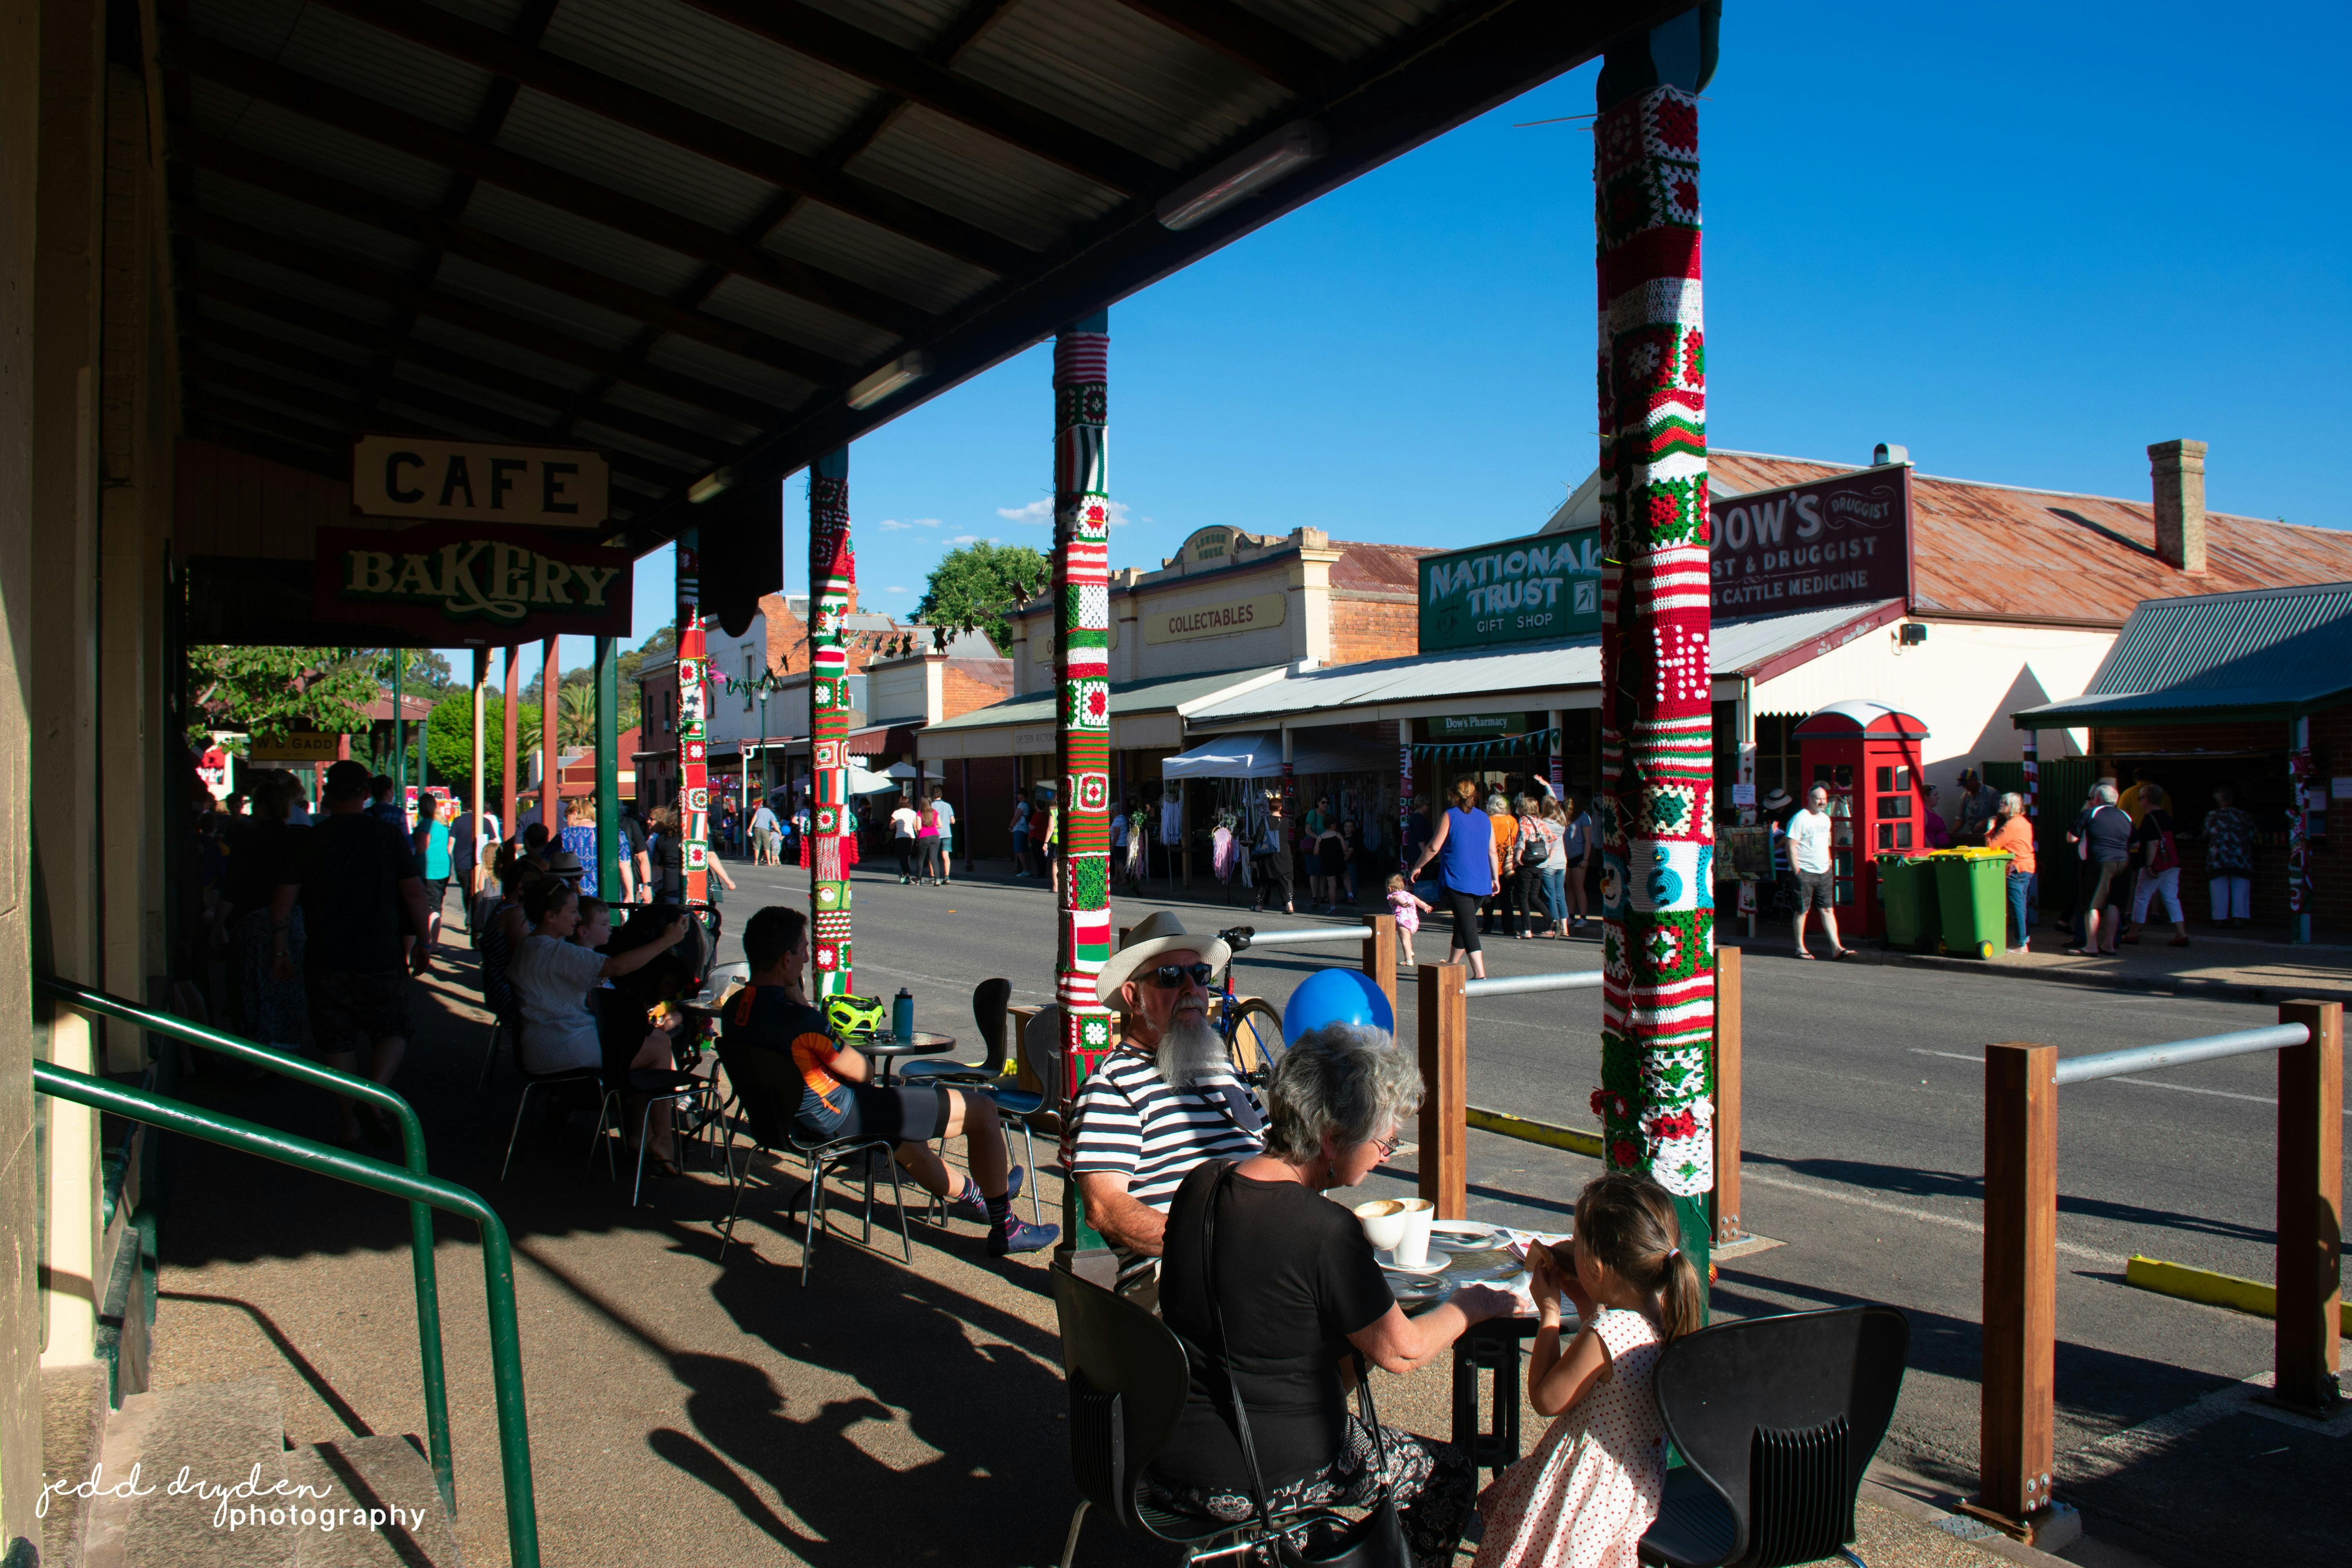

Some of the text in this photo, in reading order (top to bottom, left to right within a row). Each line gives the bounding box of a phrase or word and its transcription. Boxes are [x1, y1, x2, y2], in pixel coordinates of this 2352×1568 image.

[385, 451, 579, 514] CAFE
[1831, 496, 1890, 519] DRUGGIST
[1429, 538, 1602, 606] NATIONAL
[1764, 536, 1878, 572] DRUGGIST
[345, 539, 621, 619] BAKERY
[1722, 582, 1784, 606] CATTLE
[1788, 569, 1869, 597] MEDICINE
[1466, 577, 1564, 619] TRUST
[1169, 604, 1253, 634] COLLECTABLES
[1477, 612, 1553, 634] GIFT SHOP
[1015, 734, 1034, 744] CHILTERN
[1445, 716, 1508, 729] Dow's Pharmacy
